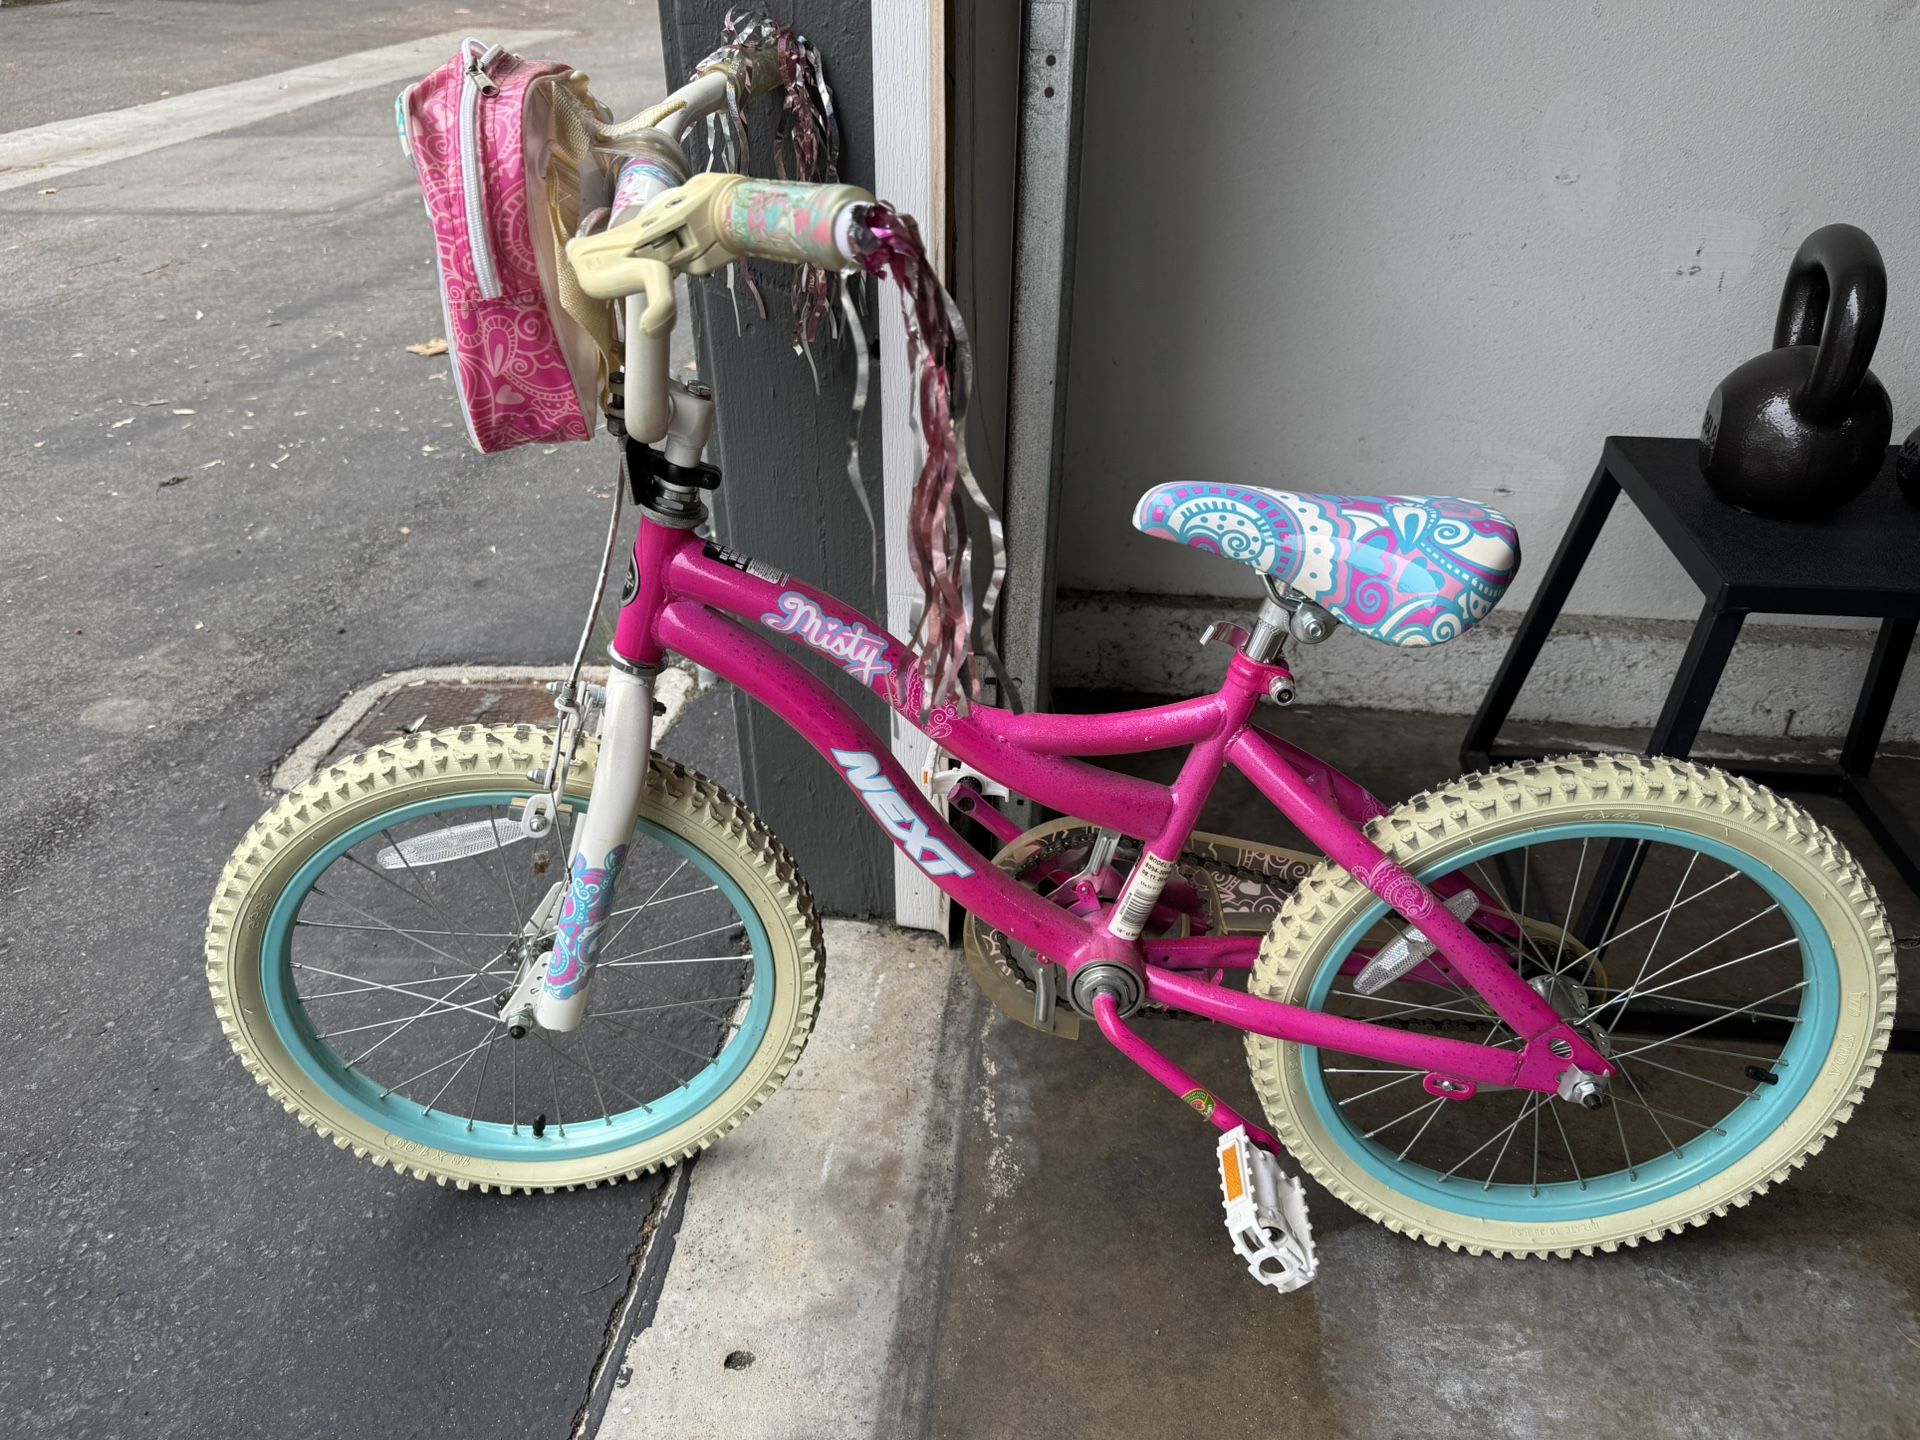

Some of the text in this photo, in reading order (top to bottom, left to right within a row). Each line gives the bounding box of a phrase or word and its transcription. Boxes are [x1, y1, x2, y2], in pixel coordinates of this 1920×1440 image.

[761, 592, 892, 687] Misty
[831, 748, 975, 878] NEXT
[1149, 855, 1167, 869] MODEL
